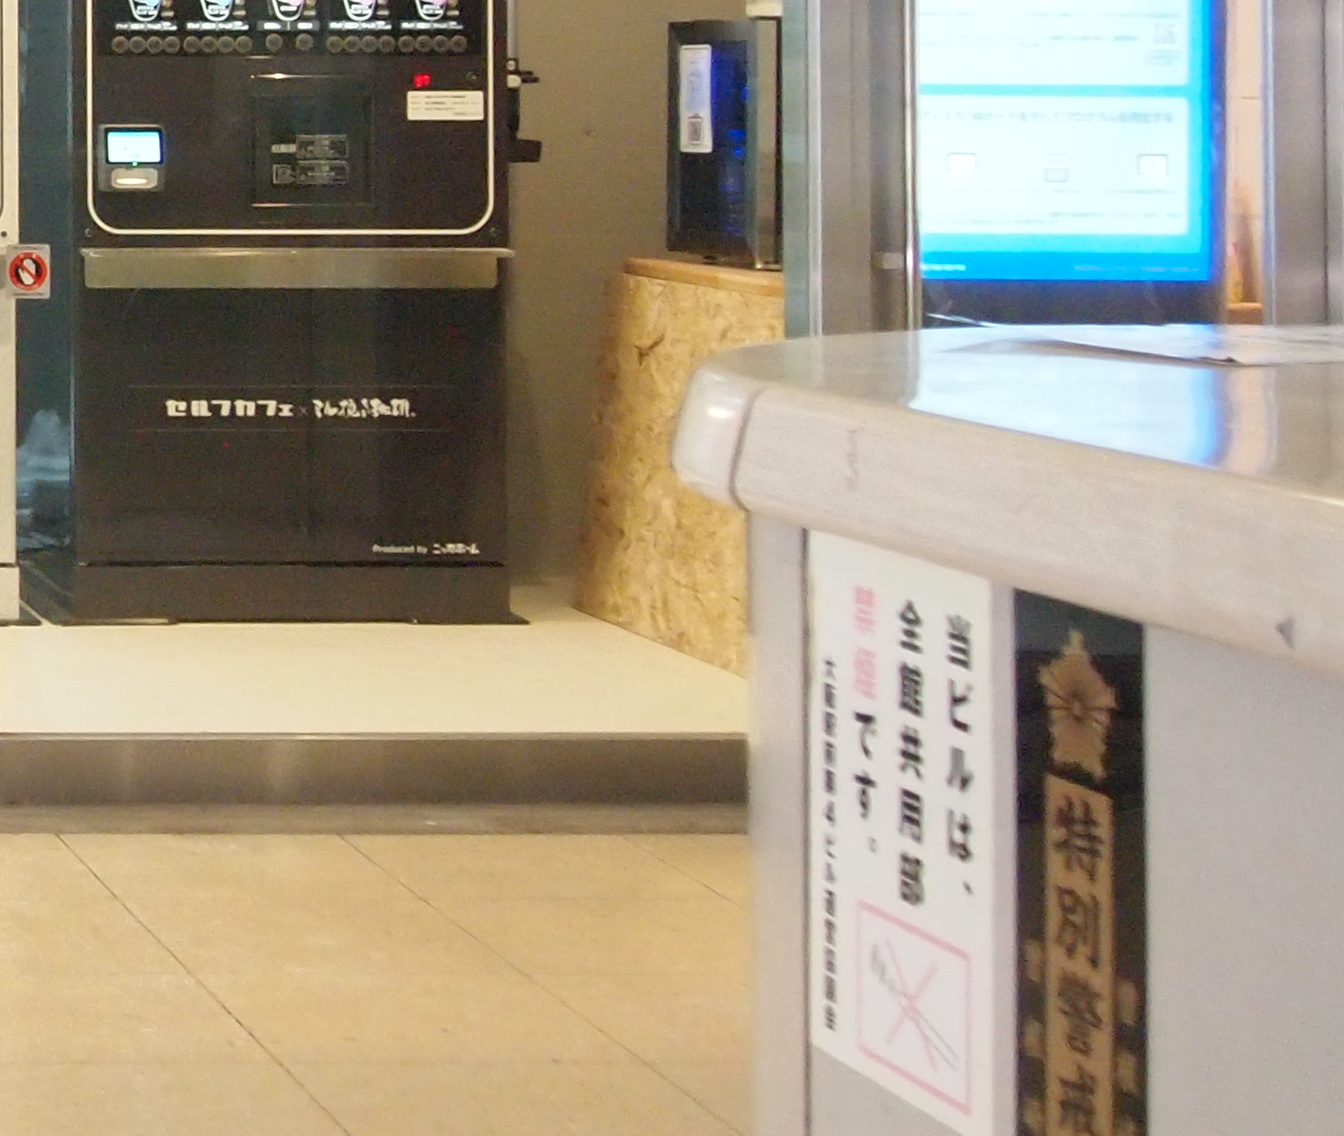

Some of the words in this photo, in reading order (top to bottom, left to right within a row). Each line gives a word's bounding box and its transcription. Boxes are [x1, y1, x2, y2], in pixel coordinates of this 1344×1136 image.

[165, 399, 294, 417] セルフカフェ
